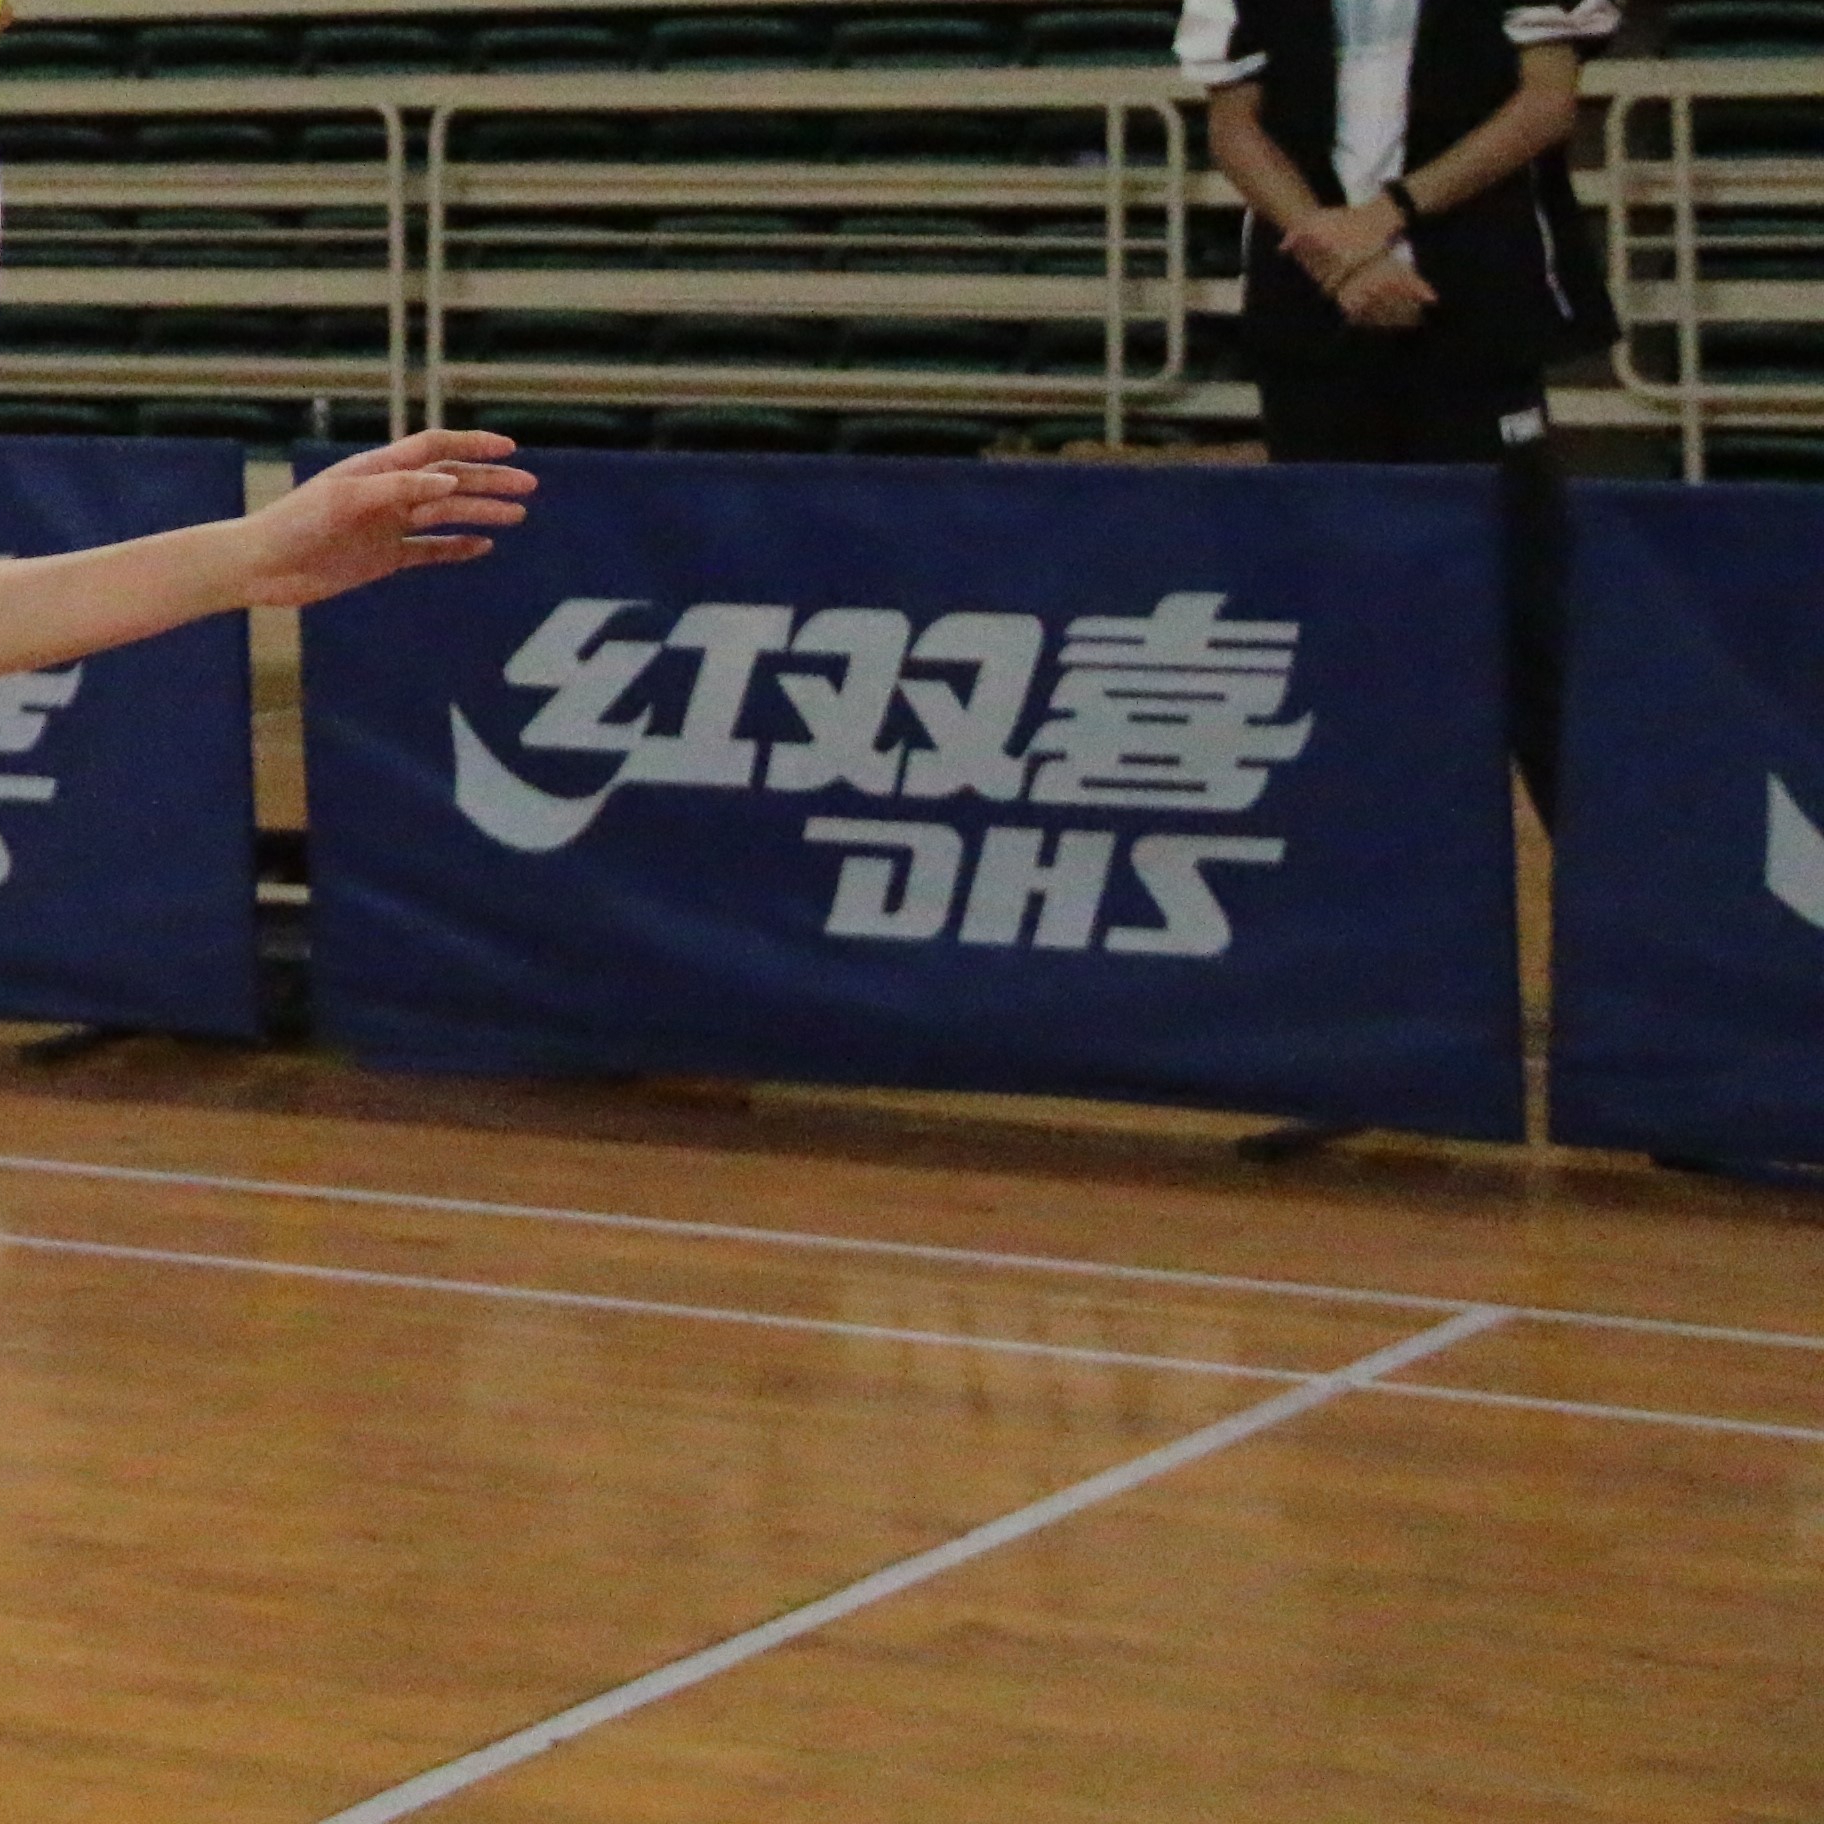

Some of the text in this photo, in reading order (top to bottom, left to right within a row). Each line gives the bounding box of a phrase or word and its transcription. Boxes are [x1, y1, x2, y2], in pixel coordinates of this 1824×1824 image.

[449, 591, 1315, 853] 红双喜
[802, 817, 1287, 956] DHS
